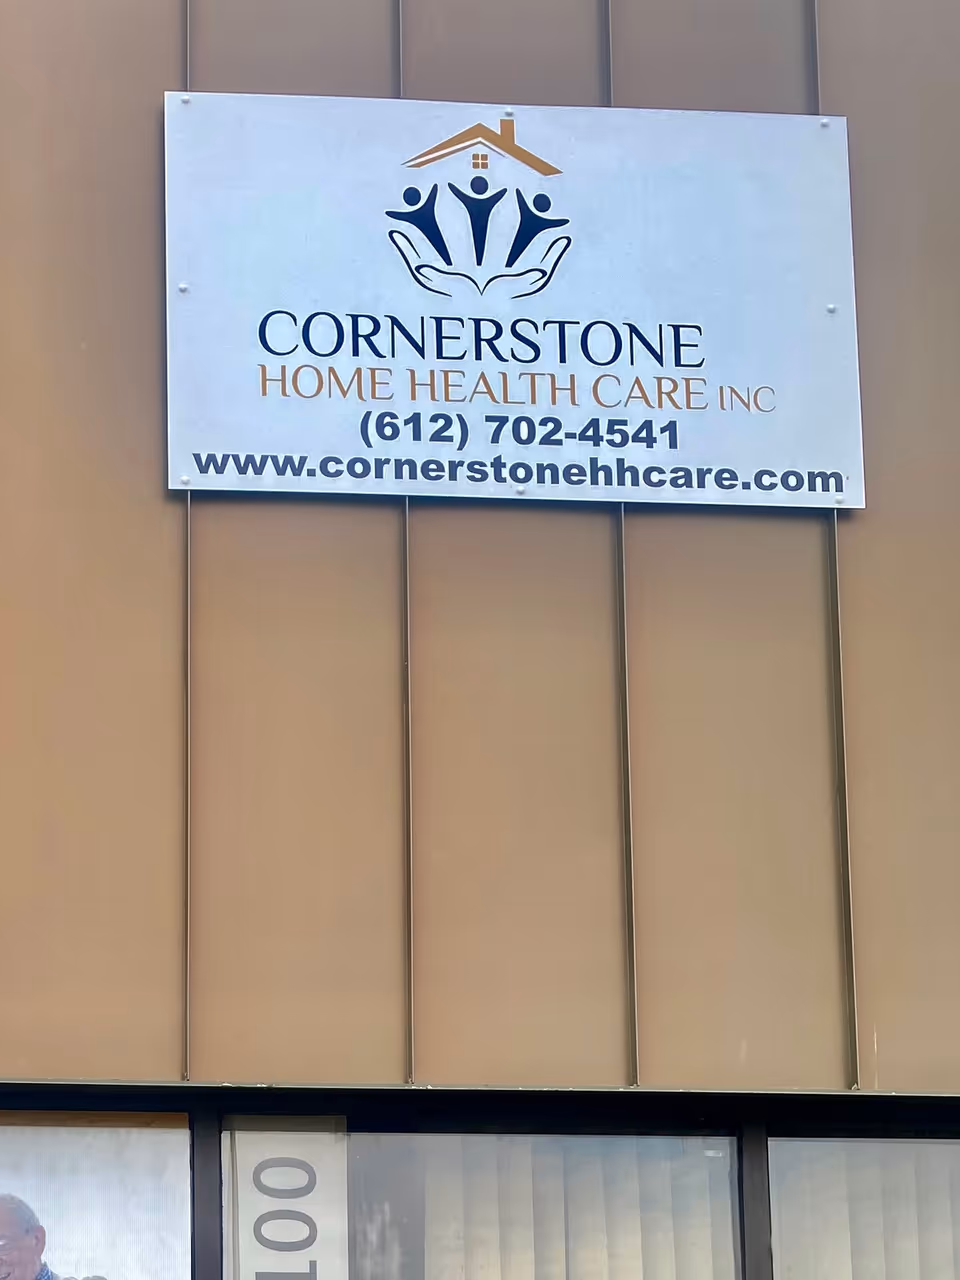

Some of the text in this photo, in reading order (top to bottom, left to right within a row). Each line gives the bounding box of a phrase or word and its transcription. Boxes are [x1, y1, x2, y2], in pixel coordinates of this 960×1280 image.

[258, 309, 706, 368] CORNERSTONE
[258, 364, 777, 414] HOME HEALTH CARE INC
[360, 410, 678, 451] (612) 702-4541
[193, 450, 844, 494] www.cornerstonehhcare.com
